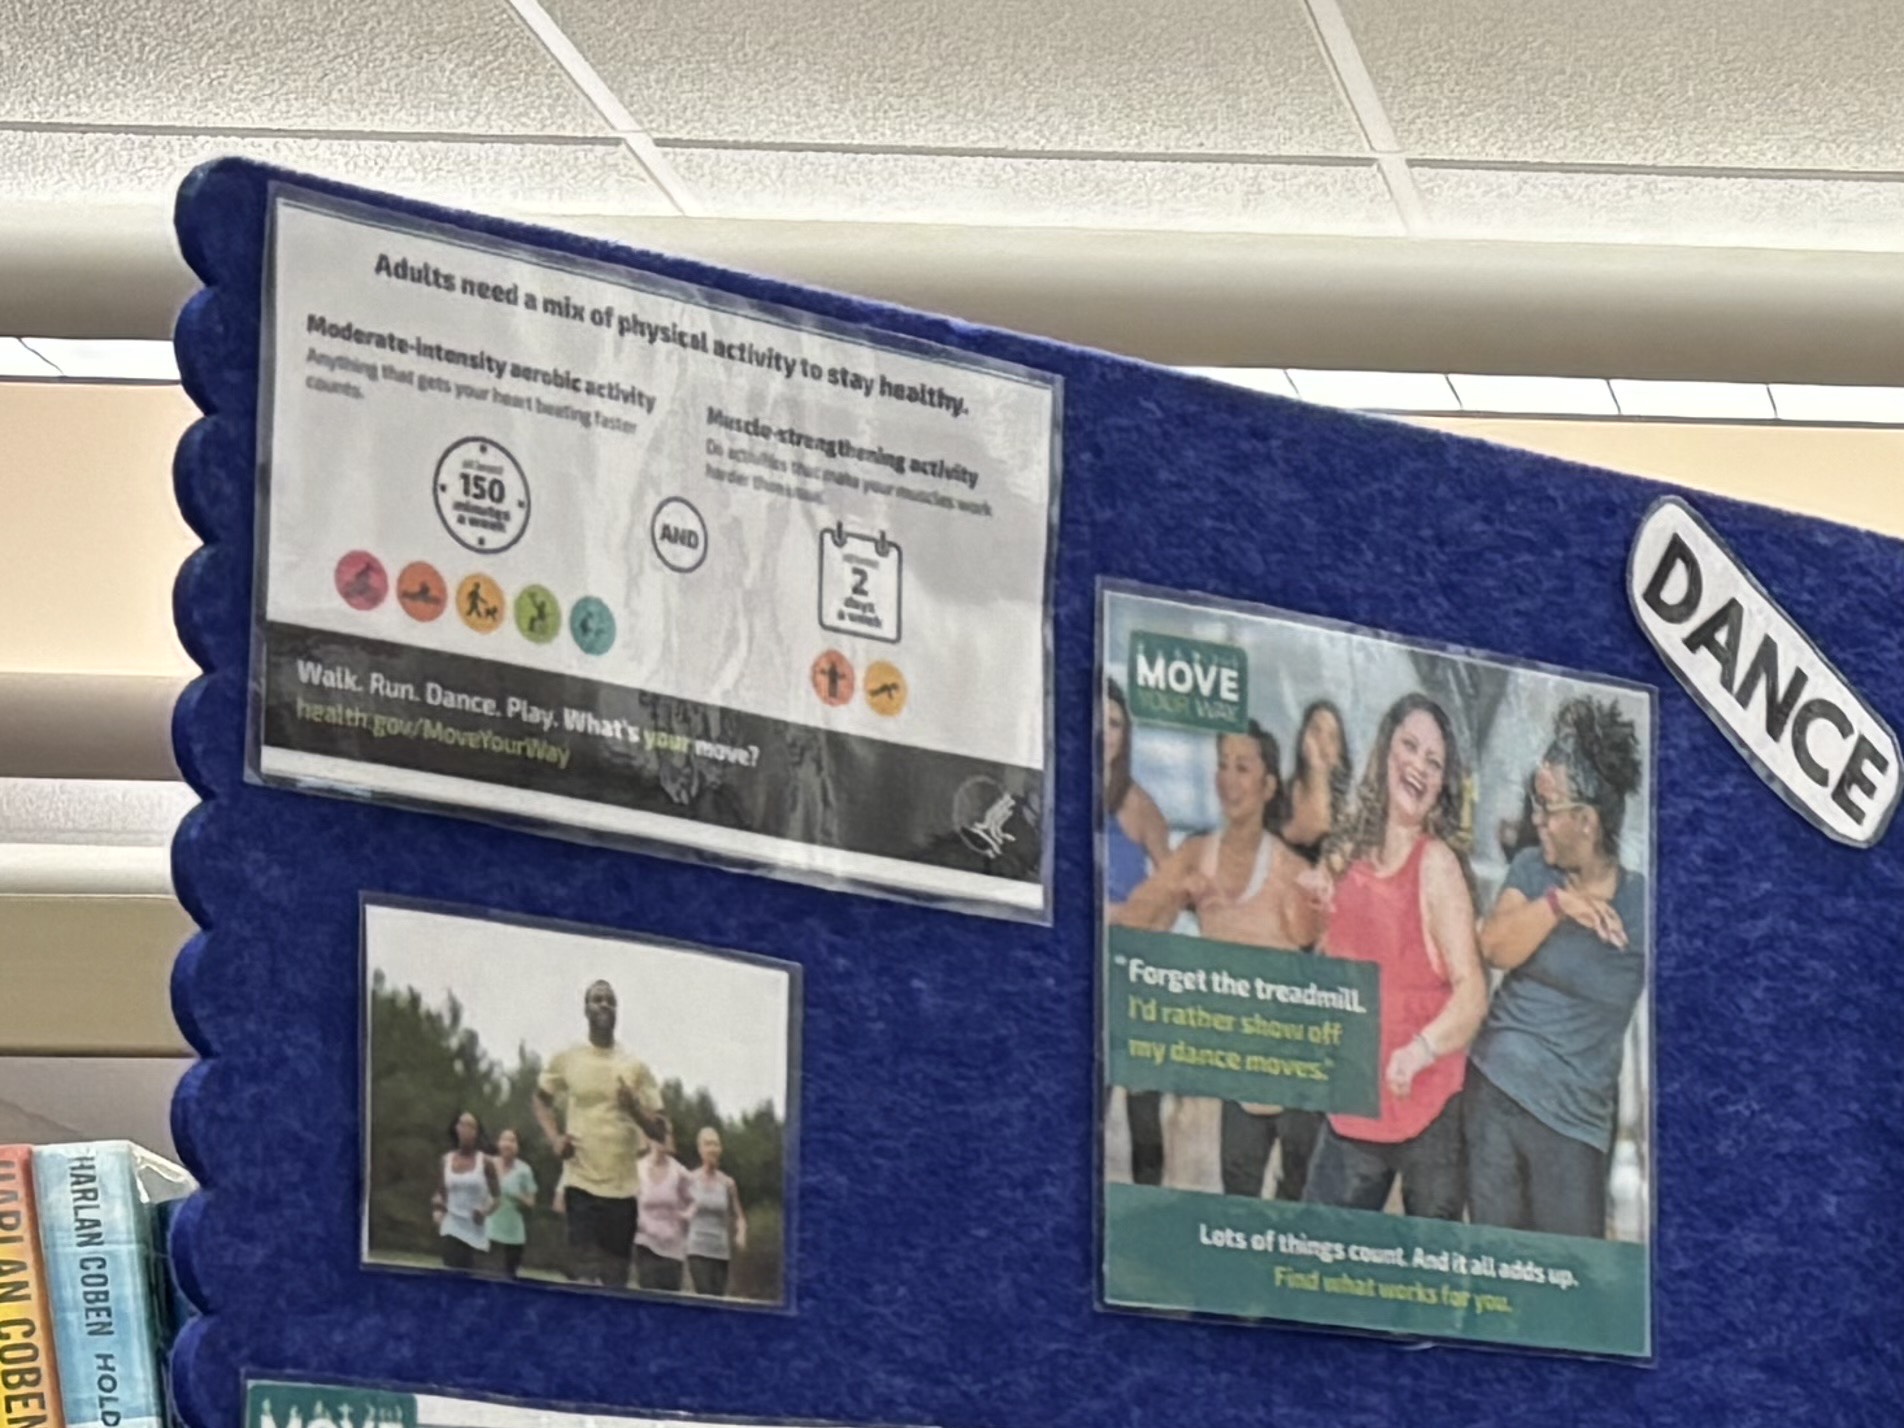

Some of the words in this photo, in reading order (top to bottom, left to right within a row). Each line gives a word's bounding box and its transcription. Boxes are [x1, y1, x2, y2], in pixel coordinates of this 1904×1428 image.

[374, 253, 456, 292] Adults
[460, 278, 519, 306] need
[524, 293, 537, 311] a
[542, 295, 585, 323] mix
[590, 306, 614, 328] of
[617, 313, 708, 353] physical
[713, 339, 797, 379] activity
[800, 358, 823, 381] to
[828, 367, 875, 397] stay
[879, 374, 969, 418] healthy.
[457, 469, 507, 504] 150
[658, 525, 701, 549] AND
[849, 567, 870, 596] 2
[297, 659, 363, 692] Walk.
[369, 672, 420, 701] Run.
[426, 682, 501, 716] Dance.
[507, 696, 558, 731] Play.
[563, 707, 640, 744] What's
[643, 729, 691, 753] your
[693, 739, 760, 767] move?
[1136, 653, 1240, 703] MOVE
[1640, 531, 1892, 829] DANCE
[1211, 970, 1251, 998] the
[68, 1154, 105, 1249] HARLAN
[79, 1256, 116, 1338] COBEN
[96, 1352, 123, 1428] HOLD
